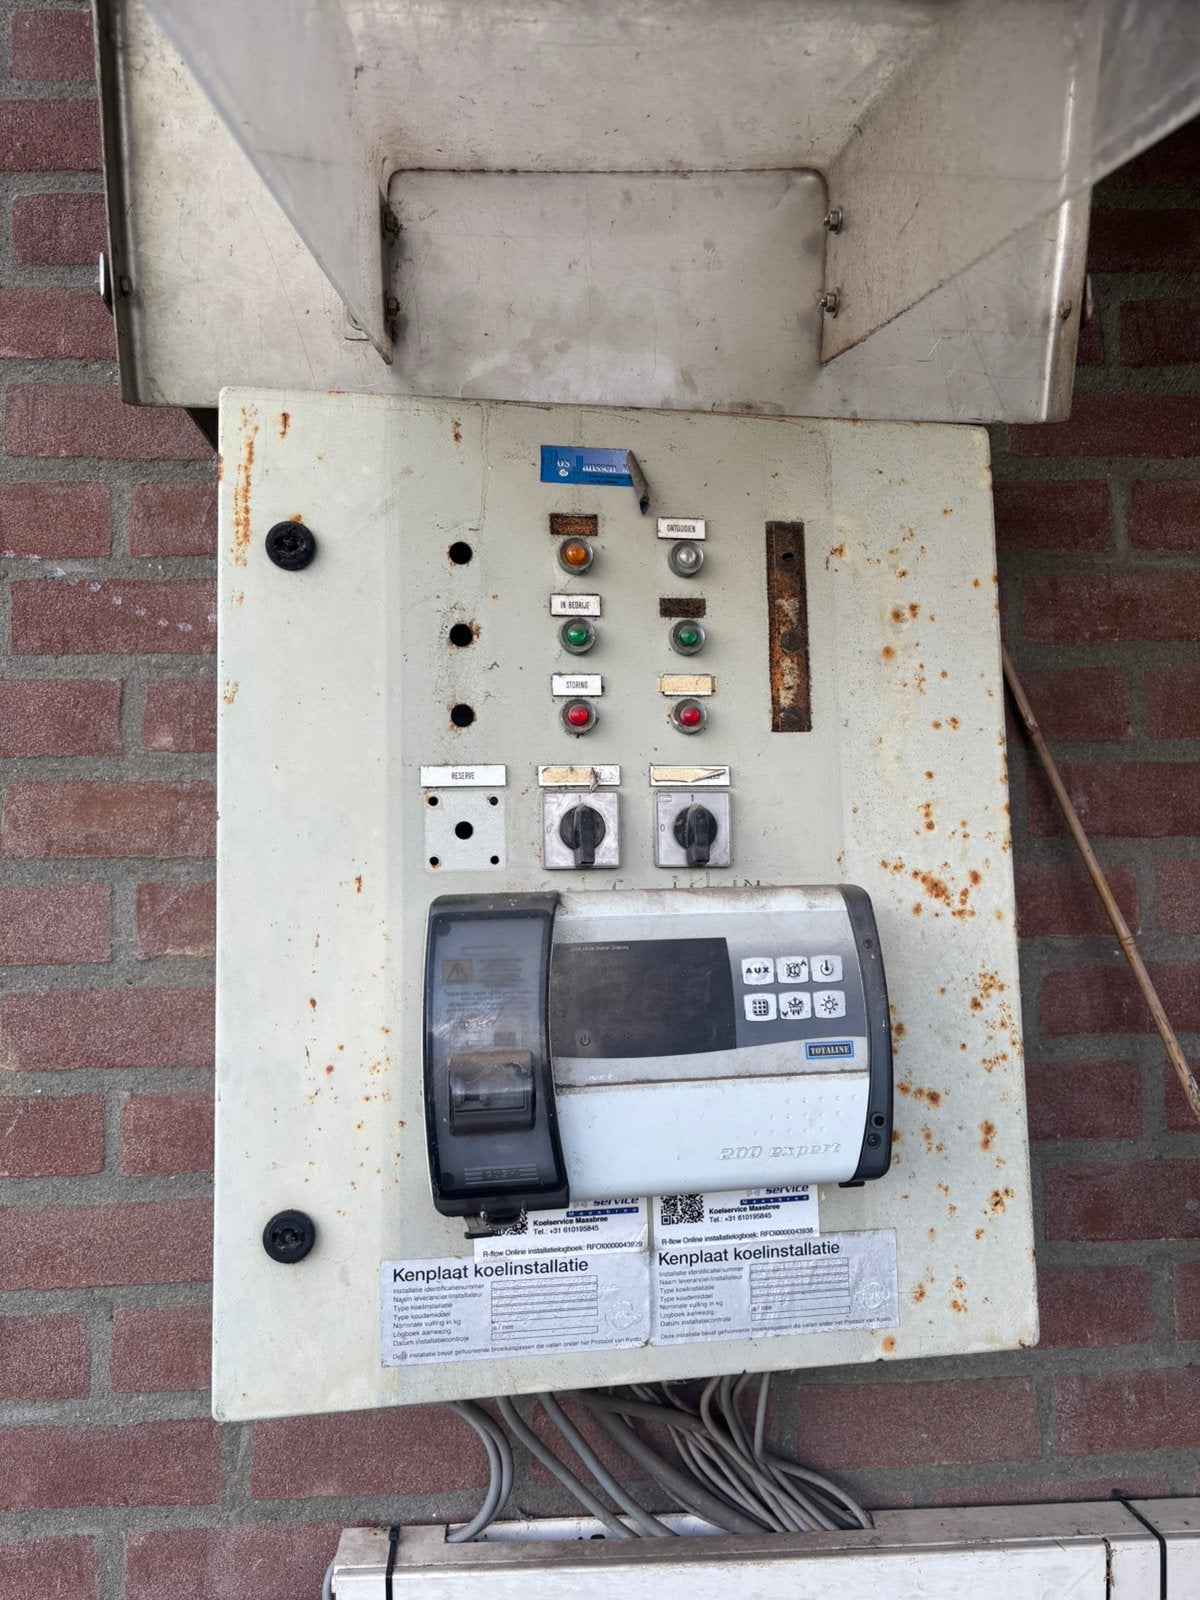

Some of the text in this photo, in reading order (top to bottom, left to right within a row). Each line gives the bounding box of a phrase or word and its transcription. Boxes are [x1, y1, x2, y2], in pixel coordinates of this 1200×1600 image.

[571, 455, 617, 474] Janssen
[666, 523, 697, 533] ONTDOOIEN
[560, 600, 590, 610] IN BEDRIJF
[565, 680, 588, 690] STORING
[451, 771, 476, 780] RESERVE
[745, 966, 770, 974] AUX
[809, 1045, 850, 1056] TOTALINE
[718, 1142, 841, 1161] 200 expert
[765, 1184, 810, 1195] service
[593, 1196, 639, 1207] service
[708, 1204, 781, 1216] Koelservice Maasbree
[533, 1216, 609, 1227] Koelservice Maasbree
[737, 1212, 772, 1222] 610195845
[533, 1228, 548, 1236] Tel.:
[563, 1225, 600, 1235] 610195845
[661, 1238, 681, 1246] R-flow
[682, 1235, 704, 1244] Online
[482, 1250, 504, 1258] R-flow
[505, 1248, 526, 1257] Online
[658, 1248, 729, 1267] Kenplaat
[733, 1242, 840, 1261] koelinstallatie
[393, 1265, 469, 1284] Kenplaat
[474, 1257, 590, 1278] koelinstallatie
[393, 1287, 424, 1295] Installatie
[659, 1287, 675, 1295] Type
[393, 1305, 409, 1313] Type
[393, 1314, 409, 1322] Type
[393, 1329, 420, 1338] Logboek
[393, 1339, 414, 1347] Datum
